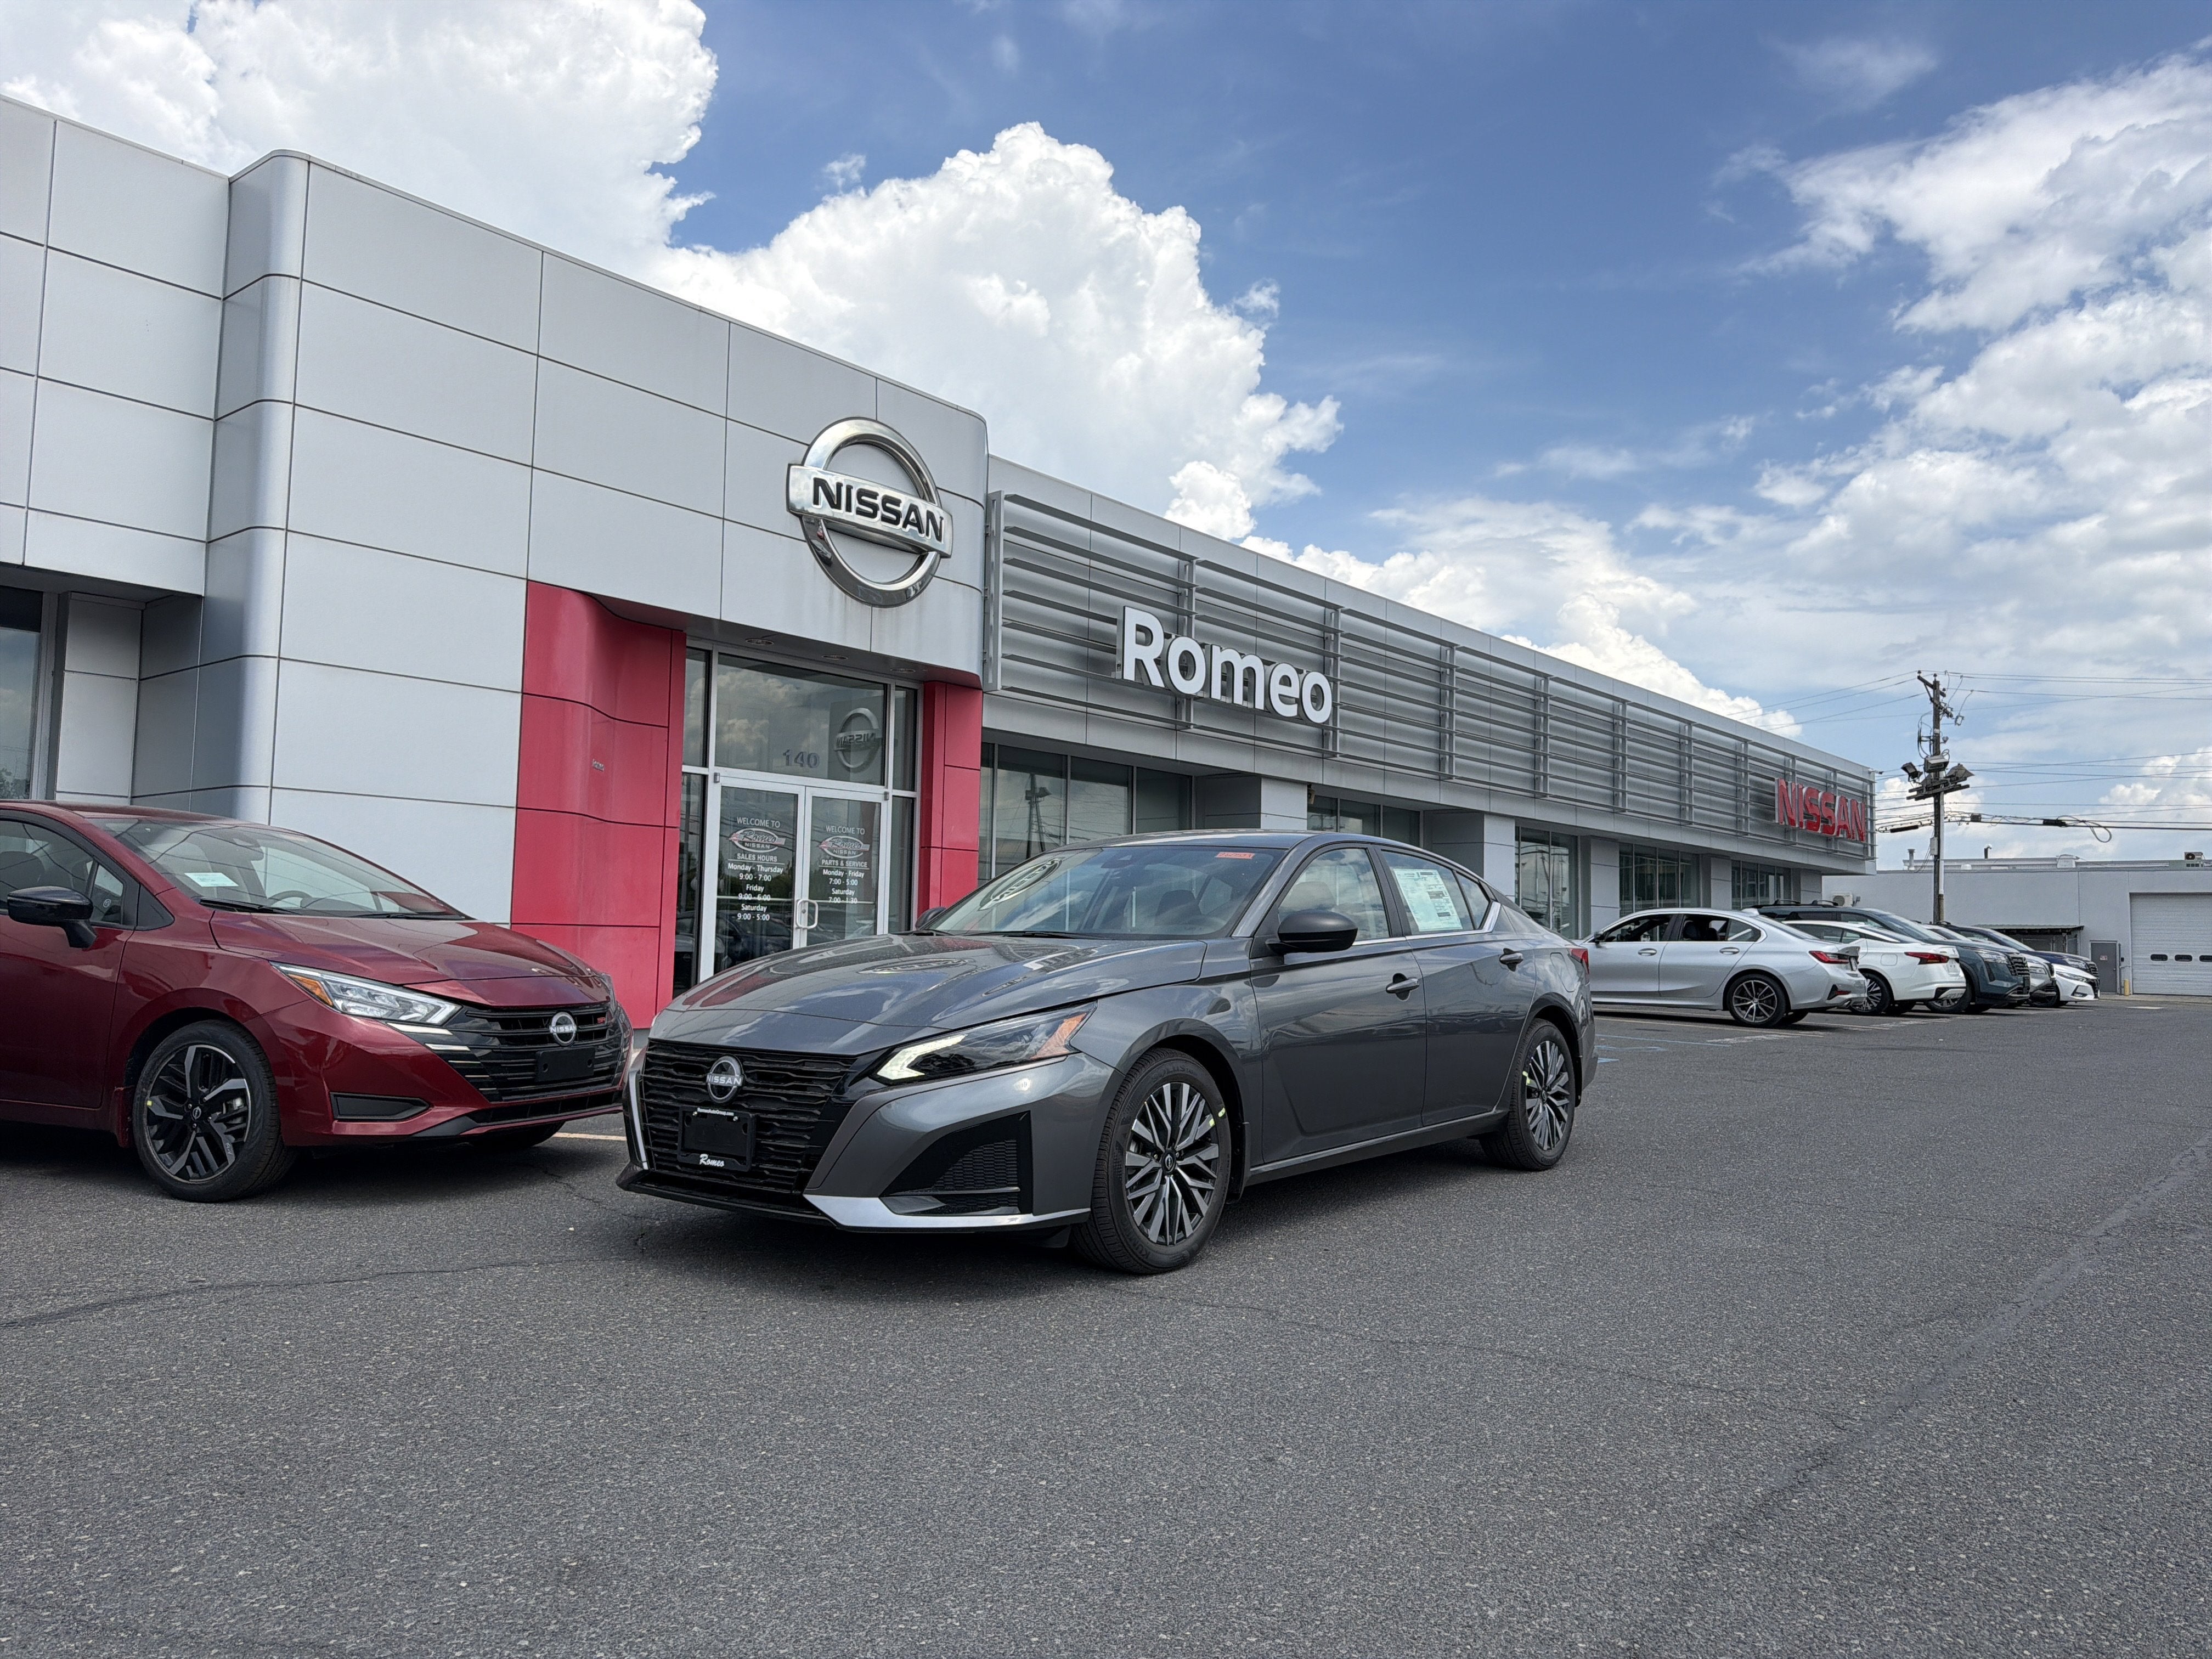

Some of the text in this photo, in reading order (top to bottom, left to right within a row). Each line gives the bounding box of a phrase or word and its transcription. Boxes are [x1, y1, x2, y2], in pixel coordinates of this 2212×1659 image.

[812, 477, 944, 543] NISSAN
[1122, 605, 1333, 724] Romeo
[782, 749, 820, 768] 140
[1776, 778, 1866, 843] NISSAN
[737, 816, 769, 827] WELCOME
[826, 825, 855, 834] WELCOME
[741, 830, 777, 843] Romeo
[737, 853, 755, 861] SALES
[728, 862, 752, 872] Monday
[757, 865, 783, 874] Thursday
[823, 868, 844, 877] Monday
[848, 870, 865, 878] Friday
[746, 884, 764, 893] Friday
[741, 904, 767, 912] Saturday
[706, 1074, 742, 1085] NISSAN
[699, 1153, 725, 1167] Romeo
